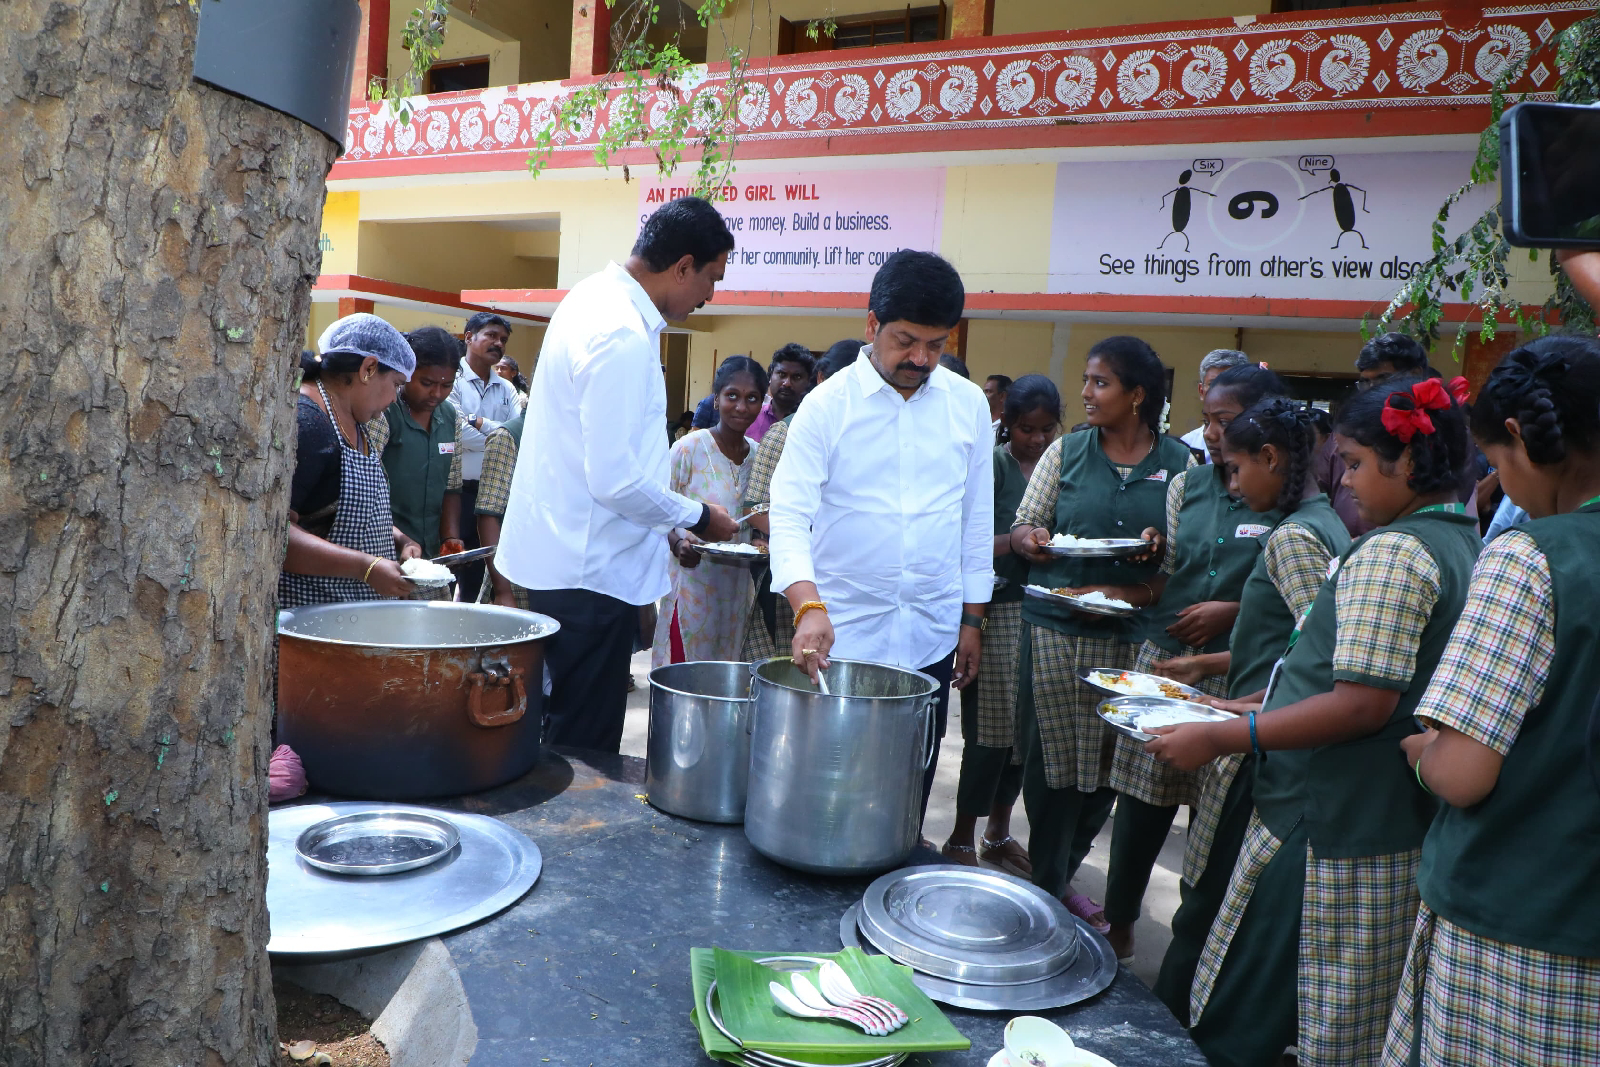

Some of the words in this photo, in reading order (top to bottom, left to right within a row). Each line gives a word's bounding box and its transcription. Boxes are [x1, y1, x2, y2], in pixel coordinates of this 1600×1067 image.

[1199, 161, 1216, 170] Six
[1304, 158, 1329, 167] Nine
[646, 188, 665, 203] AN
[745, 185, 776, 201] GIRL
[785, 184, 819, 201] WILL
[749, 216, 787, 236] money.
[793, 212, 820, 231] Build
[823, 216, 831, 231] a
[836, 211, 892, 231] business.
[741, 246, 761, 265] her
[763, 246, 821, 269] community.
[825, 246, 842, 265] Lift
[845, 246, 864, 266] her
[1099, 253, 1136, 275] See
[1144, 254, 1200, 283] things
[1208, 252, 1251, 277] from
[1259, 255, 1324, 278] other's
[1331, 255, 1373, 278] view
